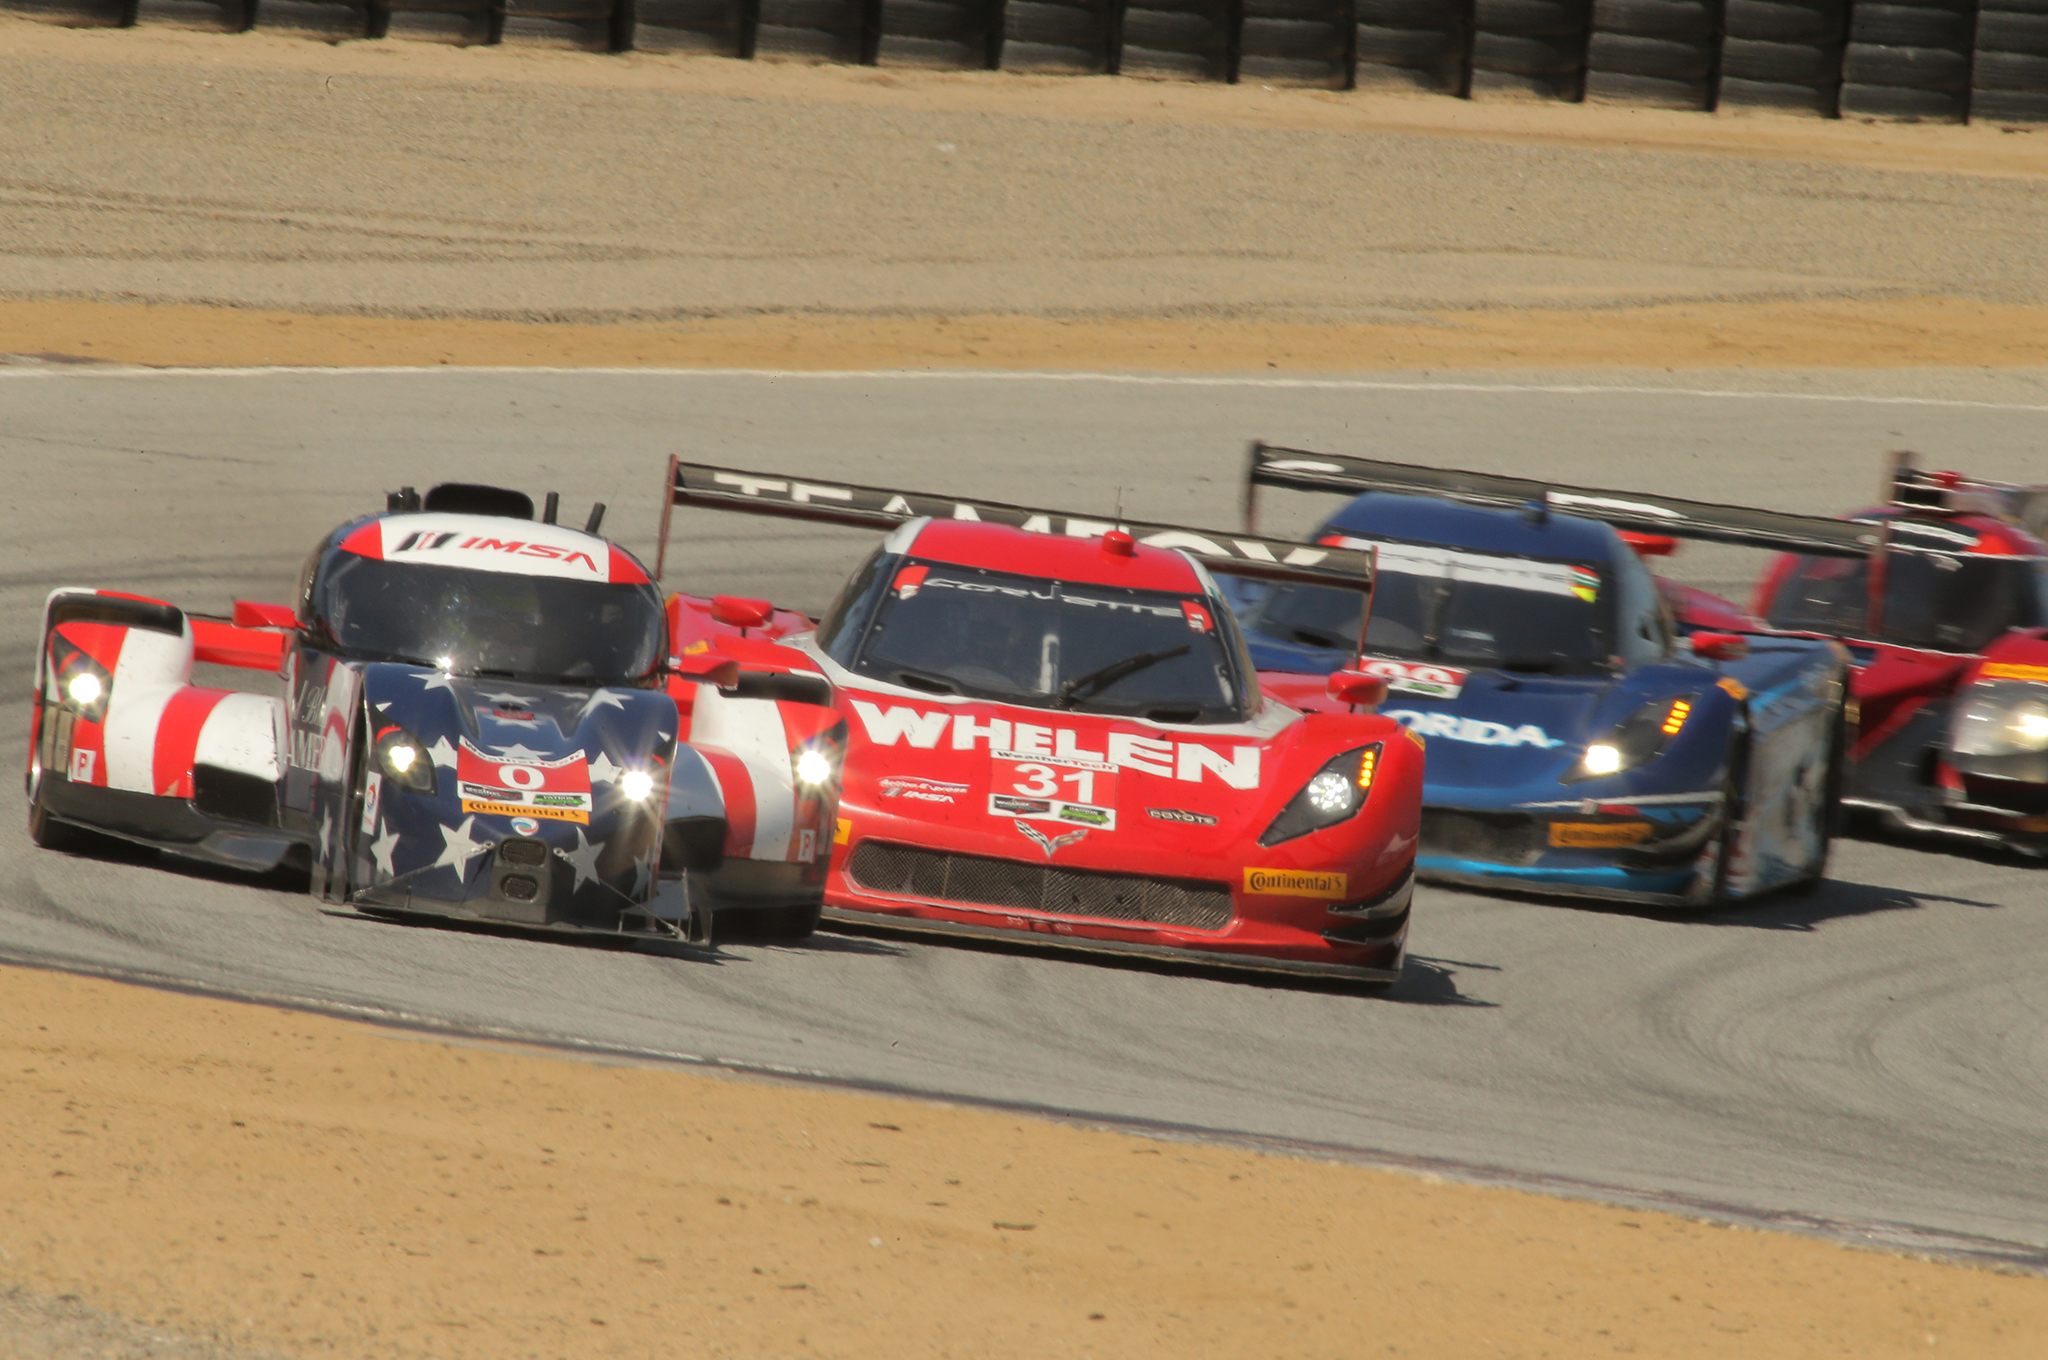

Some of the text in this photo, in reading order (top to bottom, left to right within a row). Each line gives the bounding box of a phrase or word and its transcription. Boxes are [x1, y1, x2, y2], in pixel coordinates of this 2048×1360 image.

[457, 536, 598, 574] IMSA
[850, 699, 1261, 790] WHELEN
[77, 752, 88, 778] P
[996, 751, 1114, 770] WeatherTech
[1012, 763, 1094, 804] 31
[902, 791, 955, 804] IMSA
[469, 802, 565, 817] Continental
[1149, 810, 1215, 826] COYOTE
[1249, 871, 1331, 891] Continental
